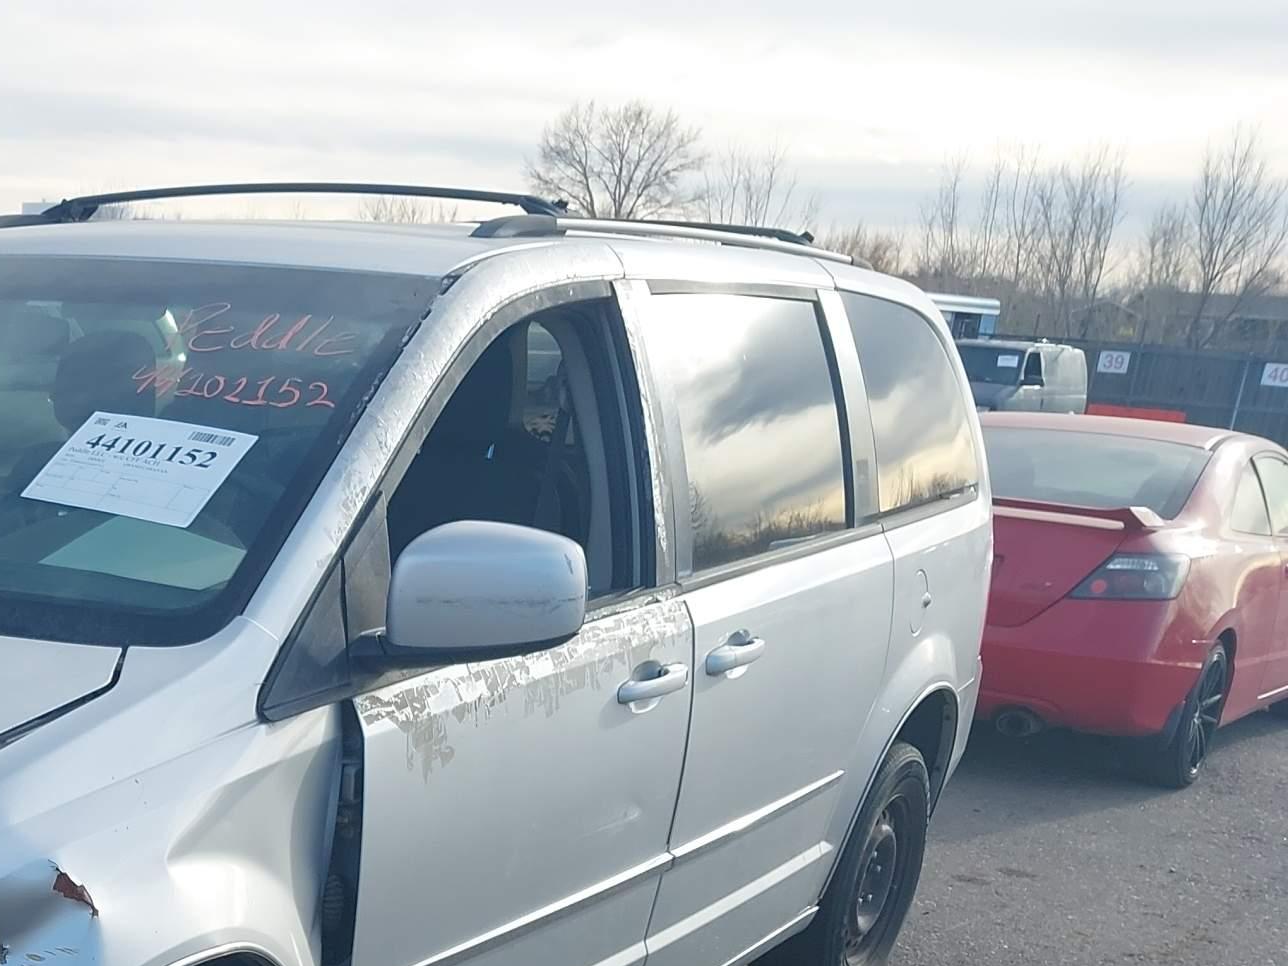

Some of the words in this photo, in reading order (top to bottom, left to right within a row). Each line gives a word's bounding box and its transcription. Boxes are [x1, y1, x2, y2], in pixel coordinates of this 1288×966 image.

[1103, 353, 1124, 370] 39
[1267, 366, 1288, 383] 40
[86, 433, 218, 469] 44101152
